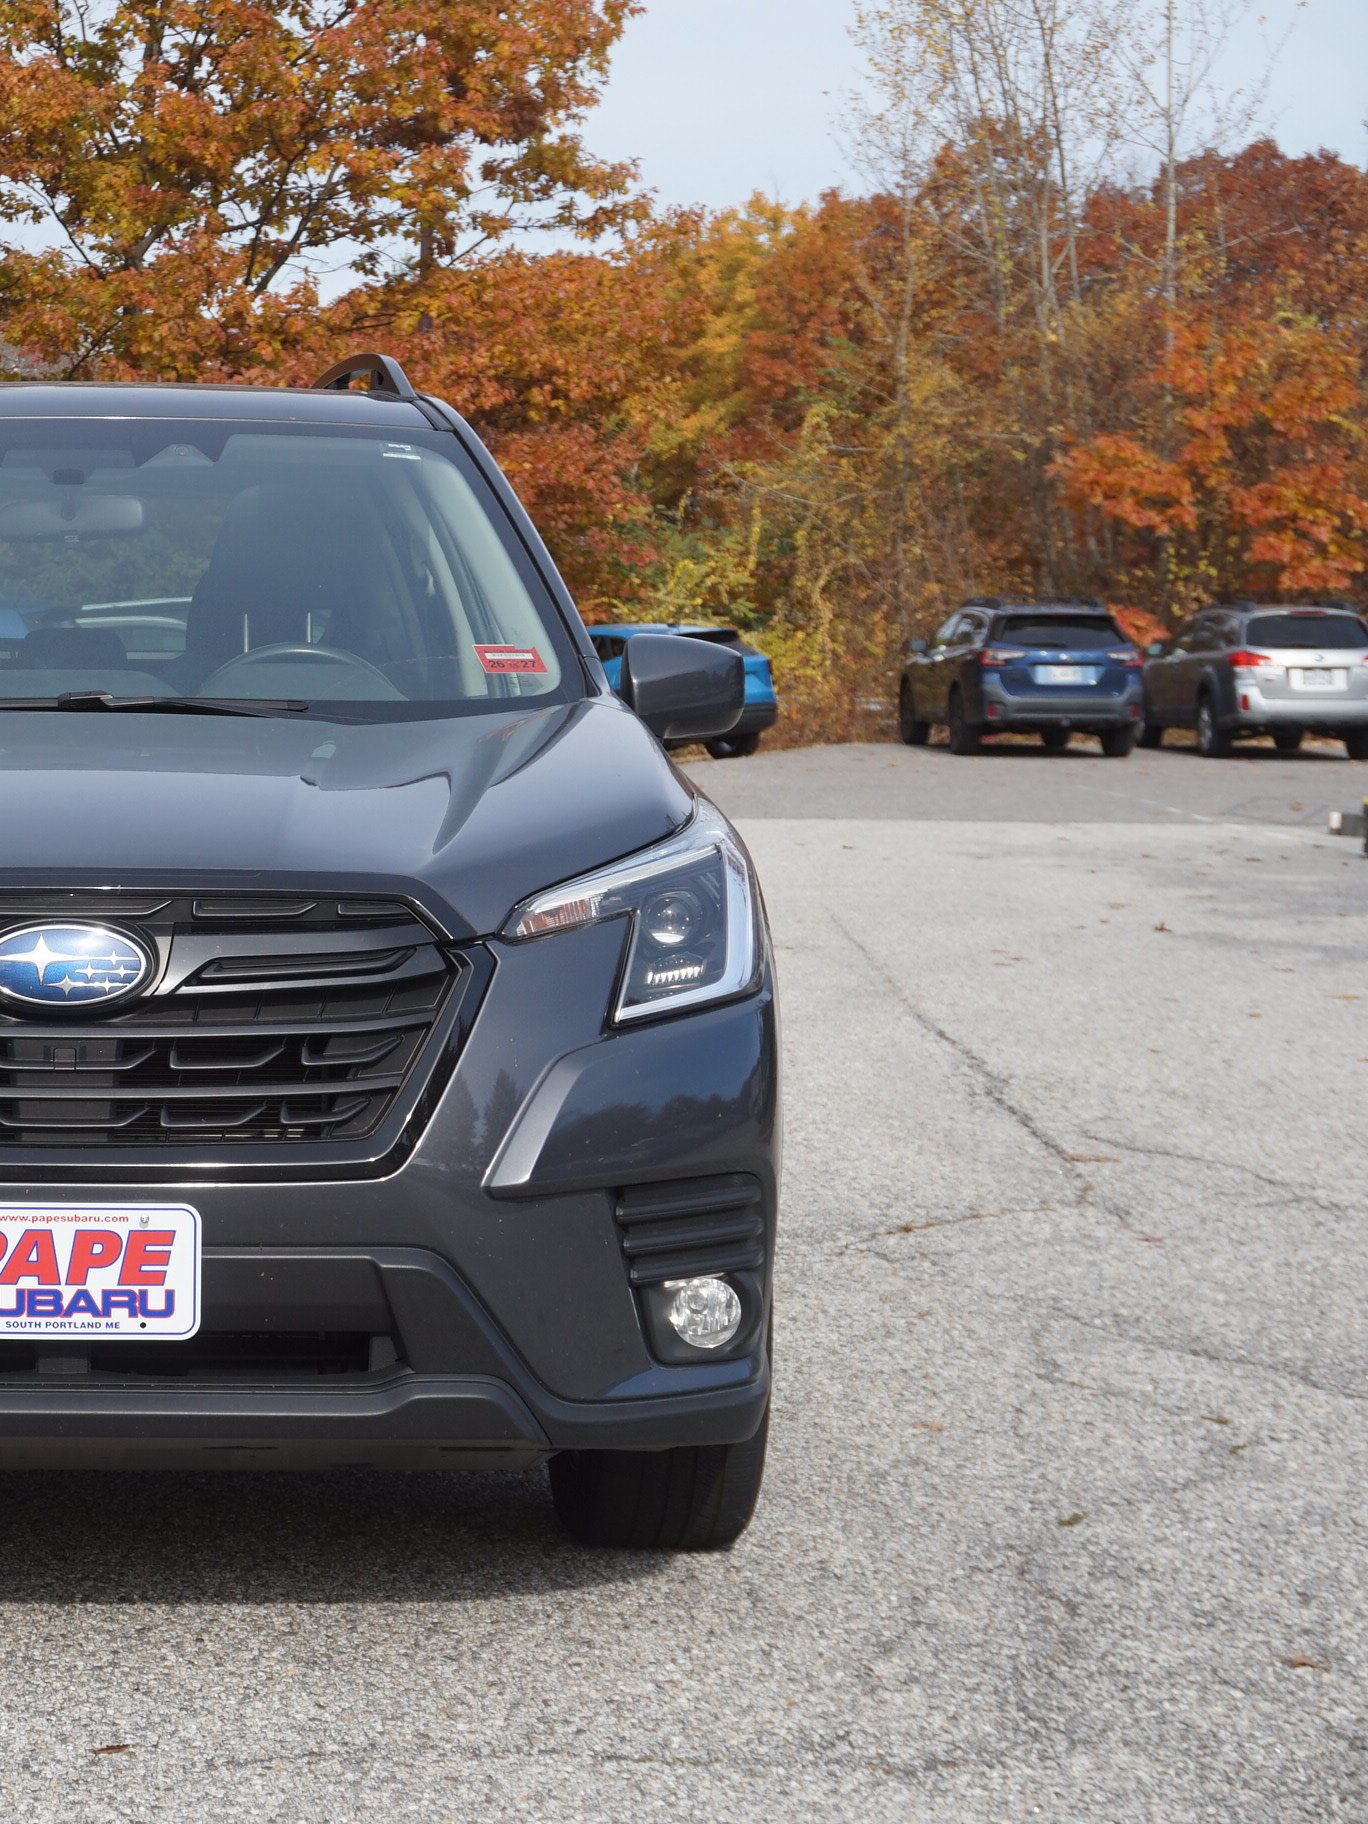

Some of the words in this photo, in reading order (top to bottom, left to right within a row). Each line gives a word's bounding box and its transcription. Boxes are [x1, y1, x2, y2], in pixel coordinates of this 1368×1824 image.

[488, 660, 505, 668] 26
[520, 660, 536, 668] 27
[5, 1320, 42, 1329] SOUTH
[45, 1321, 102, 1330] PORTLAND
[105, 1321, 121, 1330] ME
